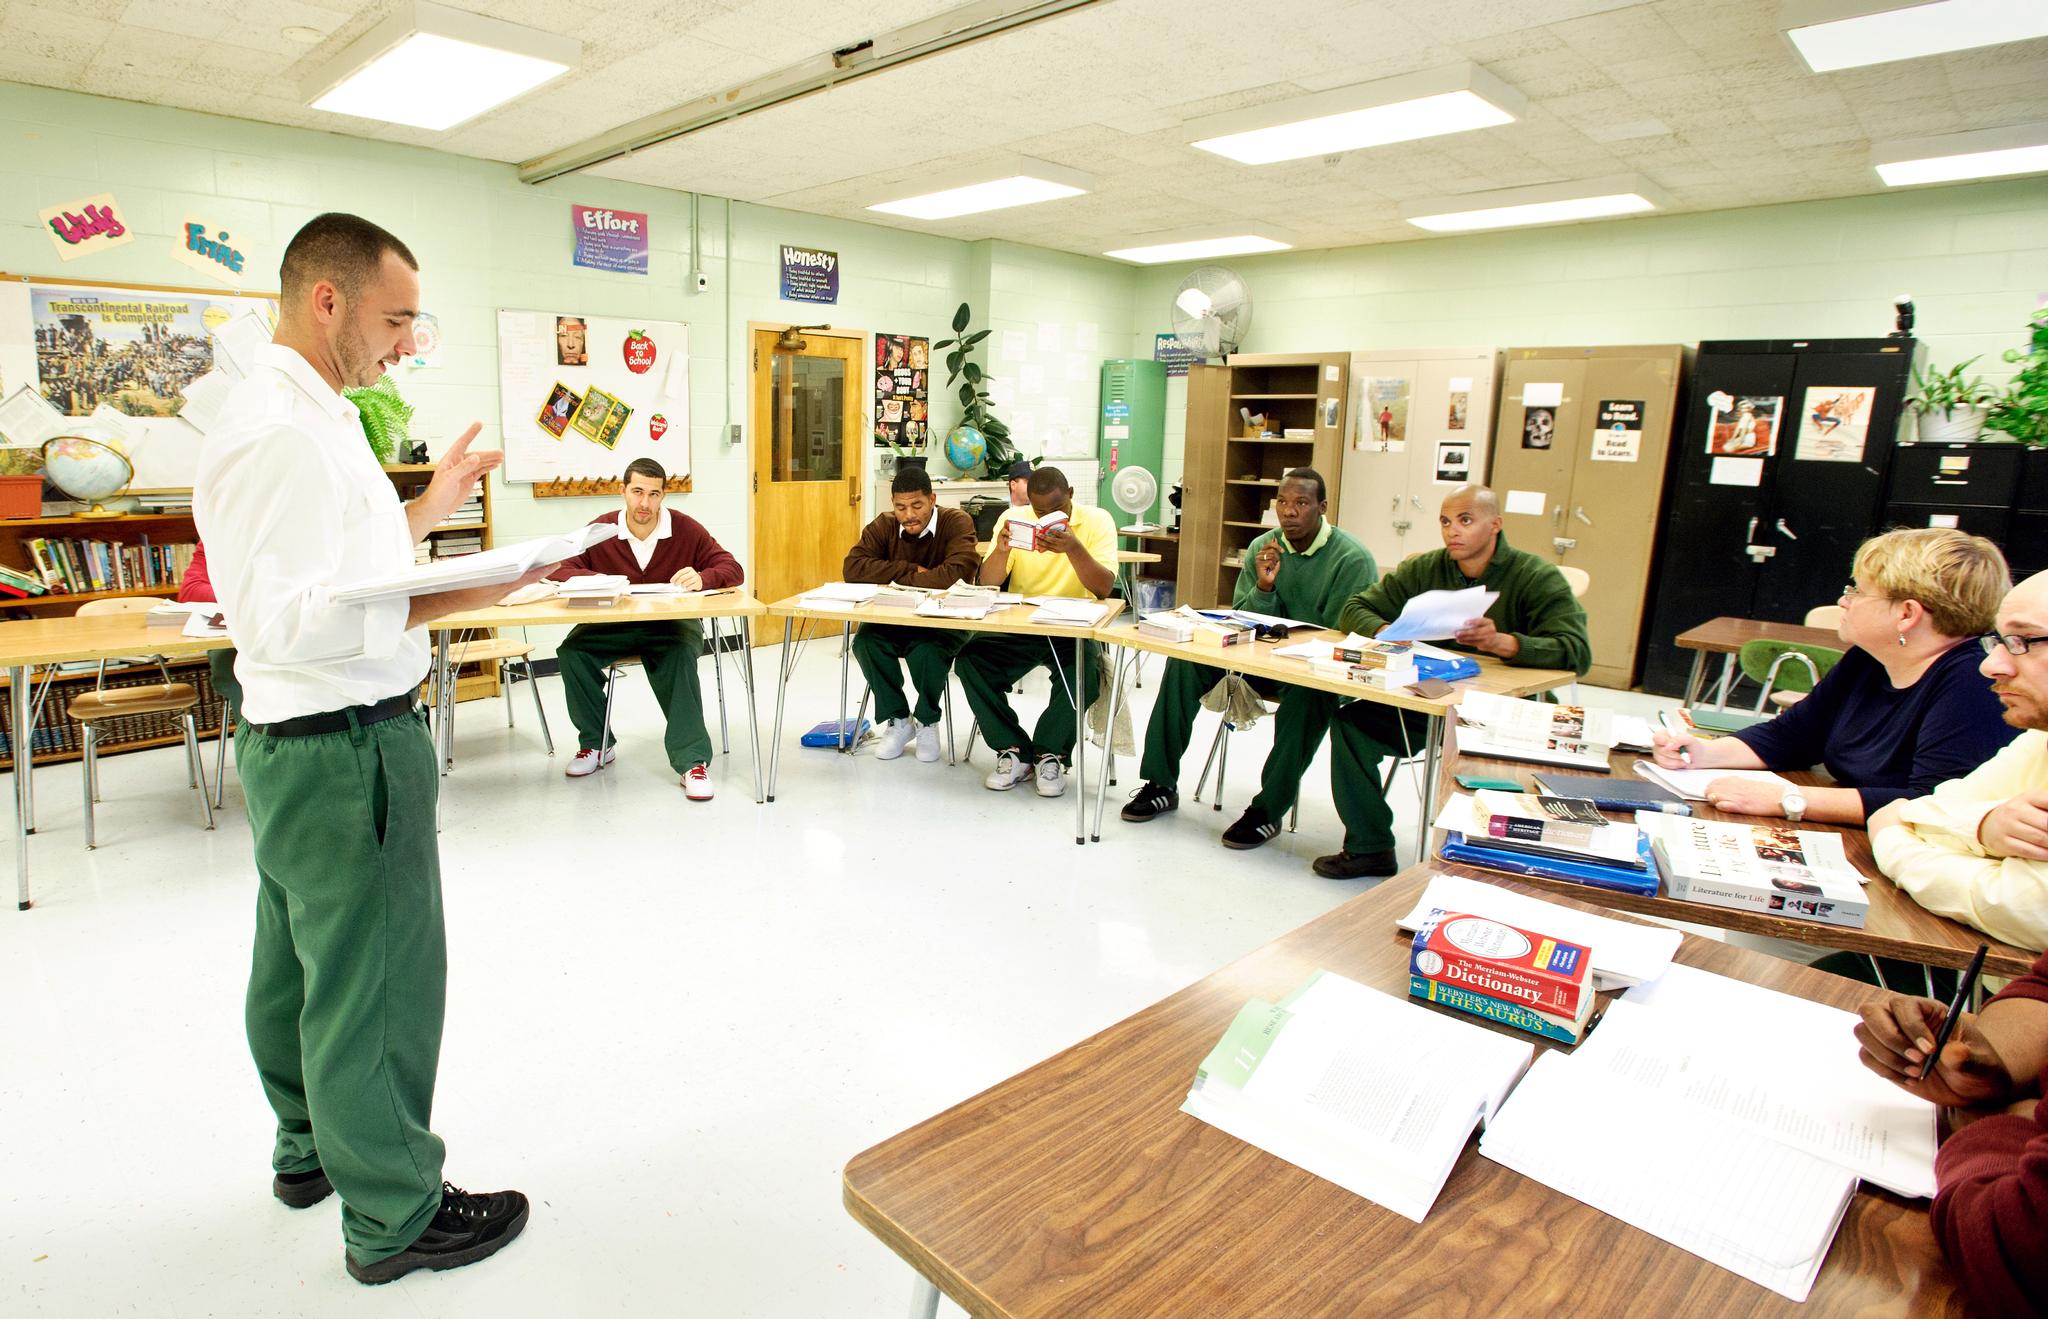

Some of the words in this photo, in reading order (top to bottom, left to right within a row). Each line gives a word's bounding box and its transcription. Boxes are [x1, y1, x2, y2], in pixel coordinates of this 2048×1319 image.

[582, 210, 639, 234] Effort
[783, 247, 835, 273] Honesty
[49, 302, 142, 314] Transcontinental
[145, 303, 189, 314] Railroad
[102, 313, 111, 322] Is
[114, 313, 174, 324] Completed!
[630, 341, 649, 351] Back
[628, 356, 652, 366] School
[1608, 402, 1635, 411] Learn
[1691, 885, 1733, 899] Literature
[1734, 891, 1747, 900] for
[1748, 893, 1765, 904] Life
[1445, 963, 1543, 1005] Dictionary
[1457, 959, 1473, 969] The
[1474, 963, 1540, 986] Merriam-Webster
[1438, 985, 1489, 1006] WEBSTER'S
[1490, 1000, 1512, 1014] NEW
[1438, 992, 1544, 1032] THESAURUS
[1234, 1046, 1257, 1072] 11
